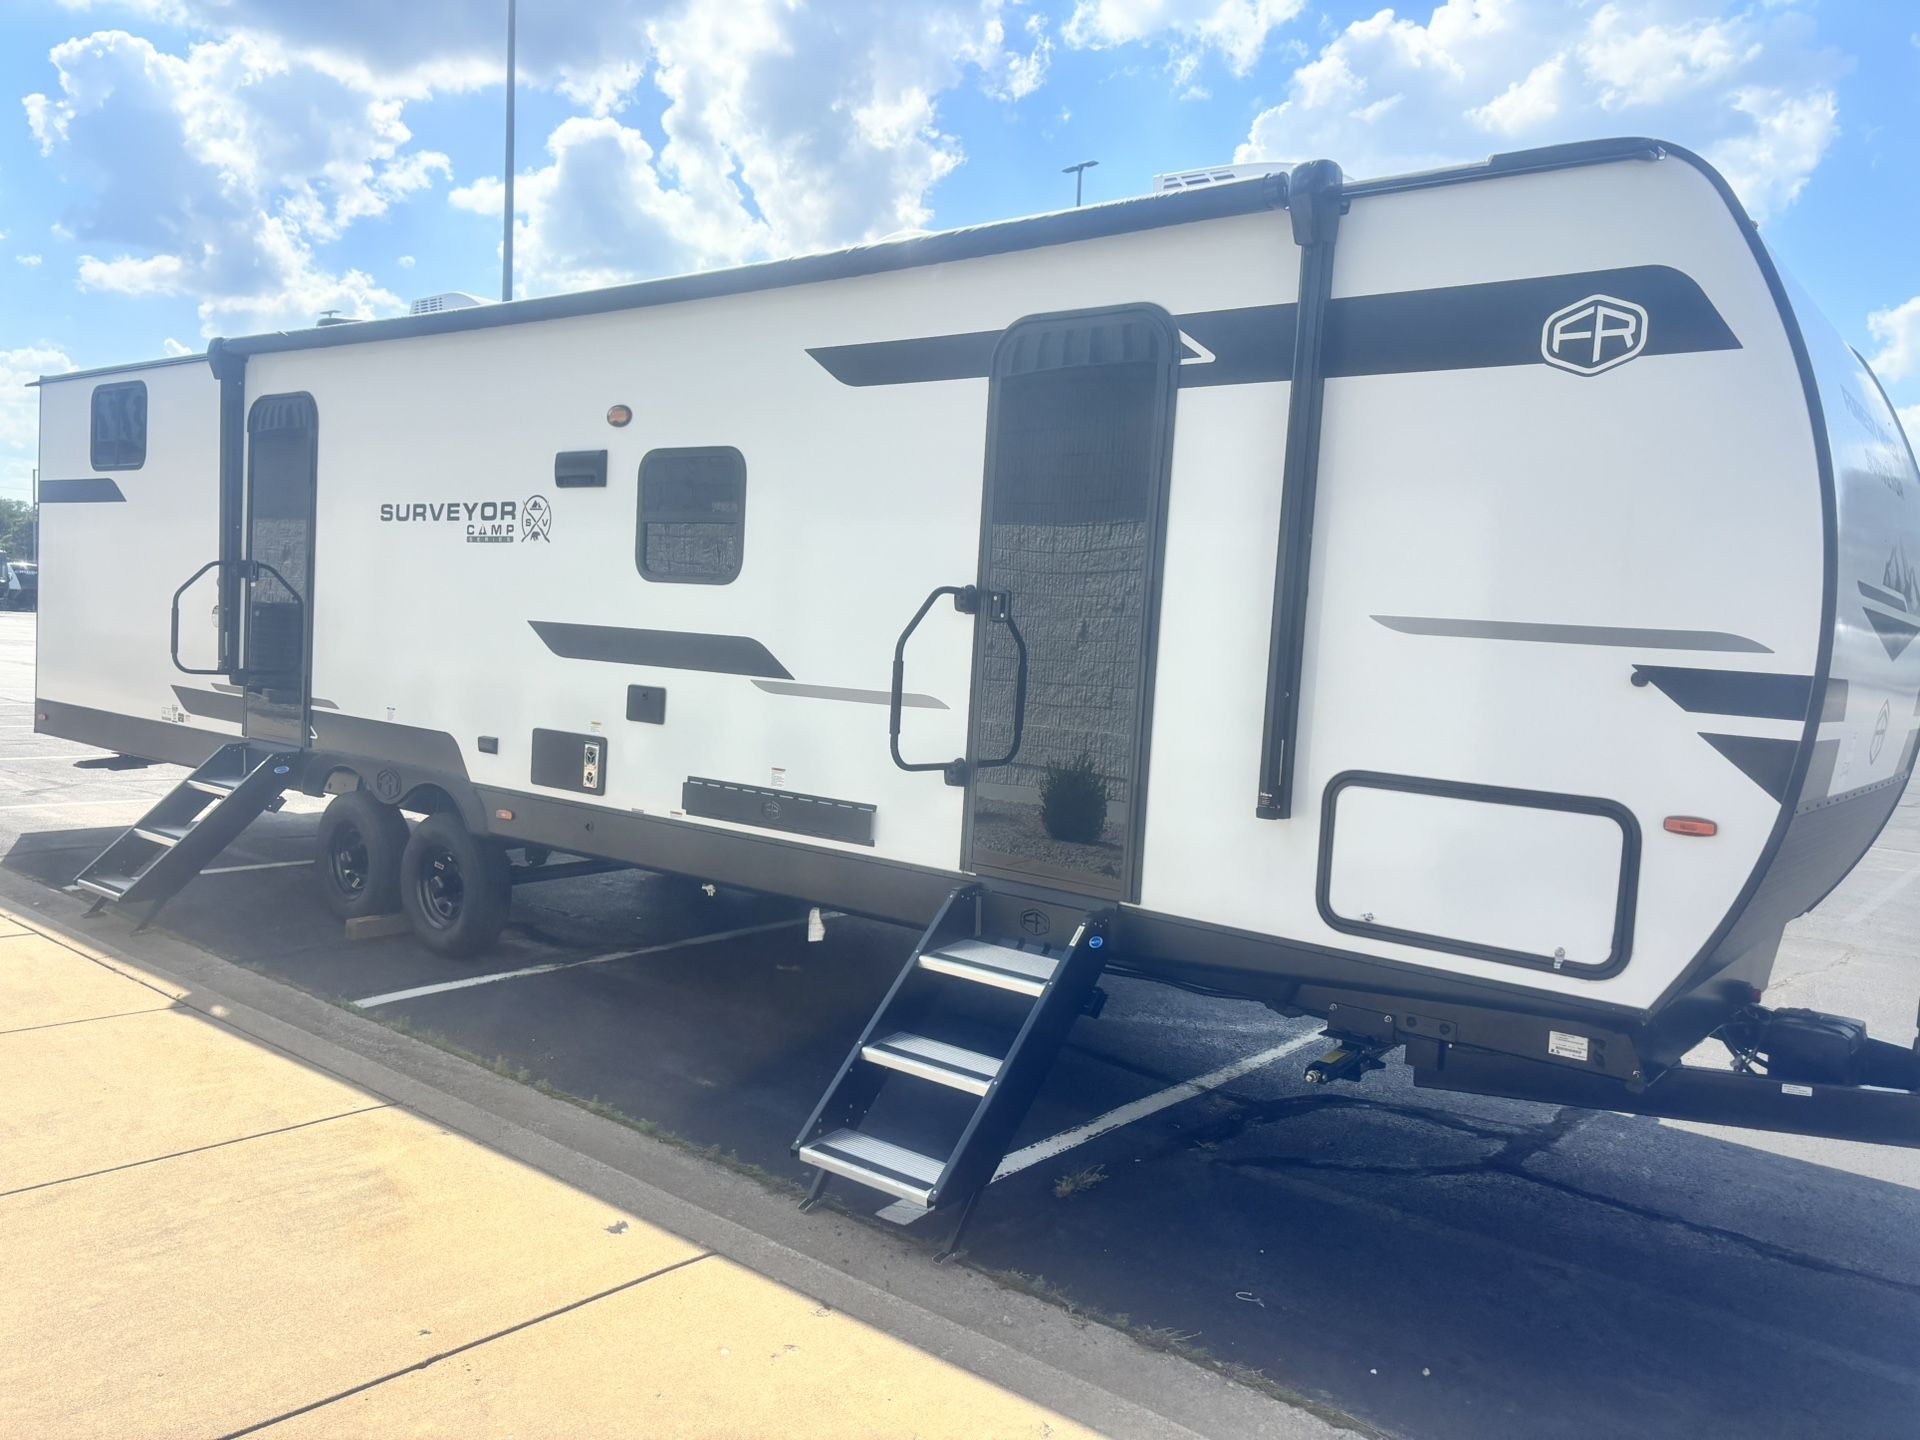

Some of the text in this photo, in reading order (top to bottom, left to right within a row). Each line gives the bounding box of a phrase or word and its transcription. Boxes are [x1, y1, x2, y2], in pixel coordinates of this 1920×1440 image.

[1552, 305, 1636, 363] FR
[380, 502, 516, 521] SURVEYOR
[466, 524, 515, 535] CAMP
